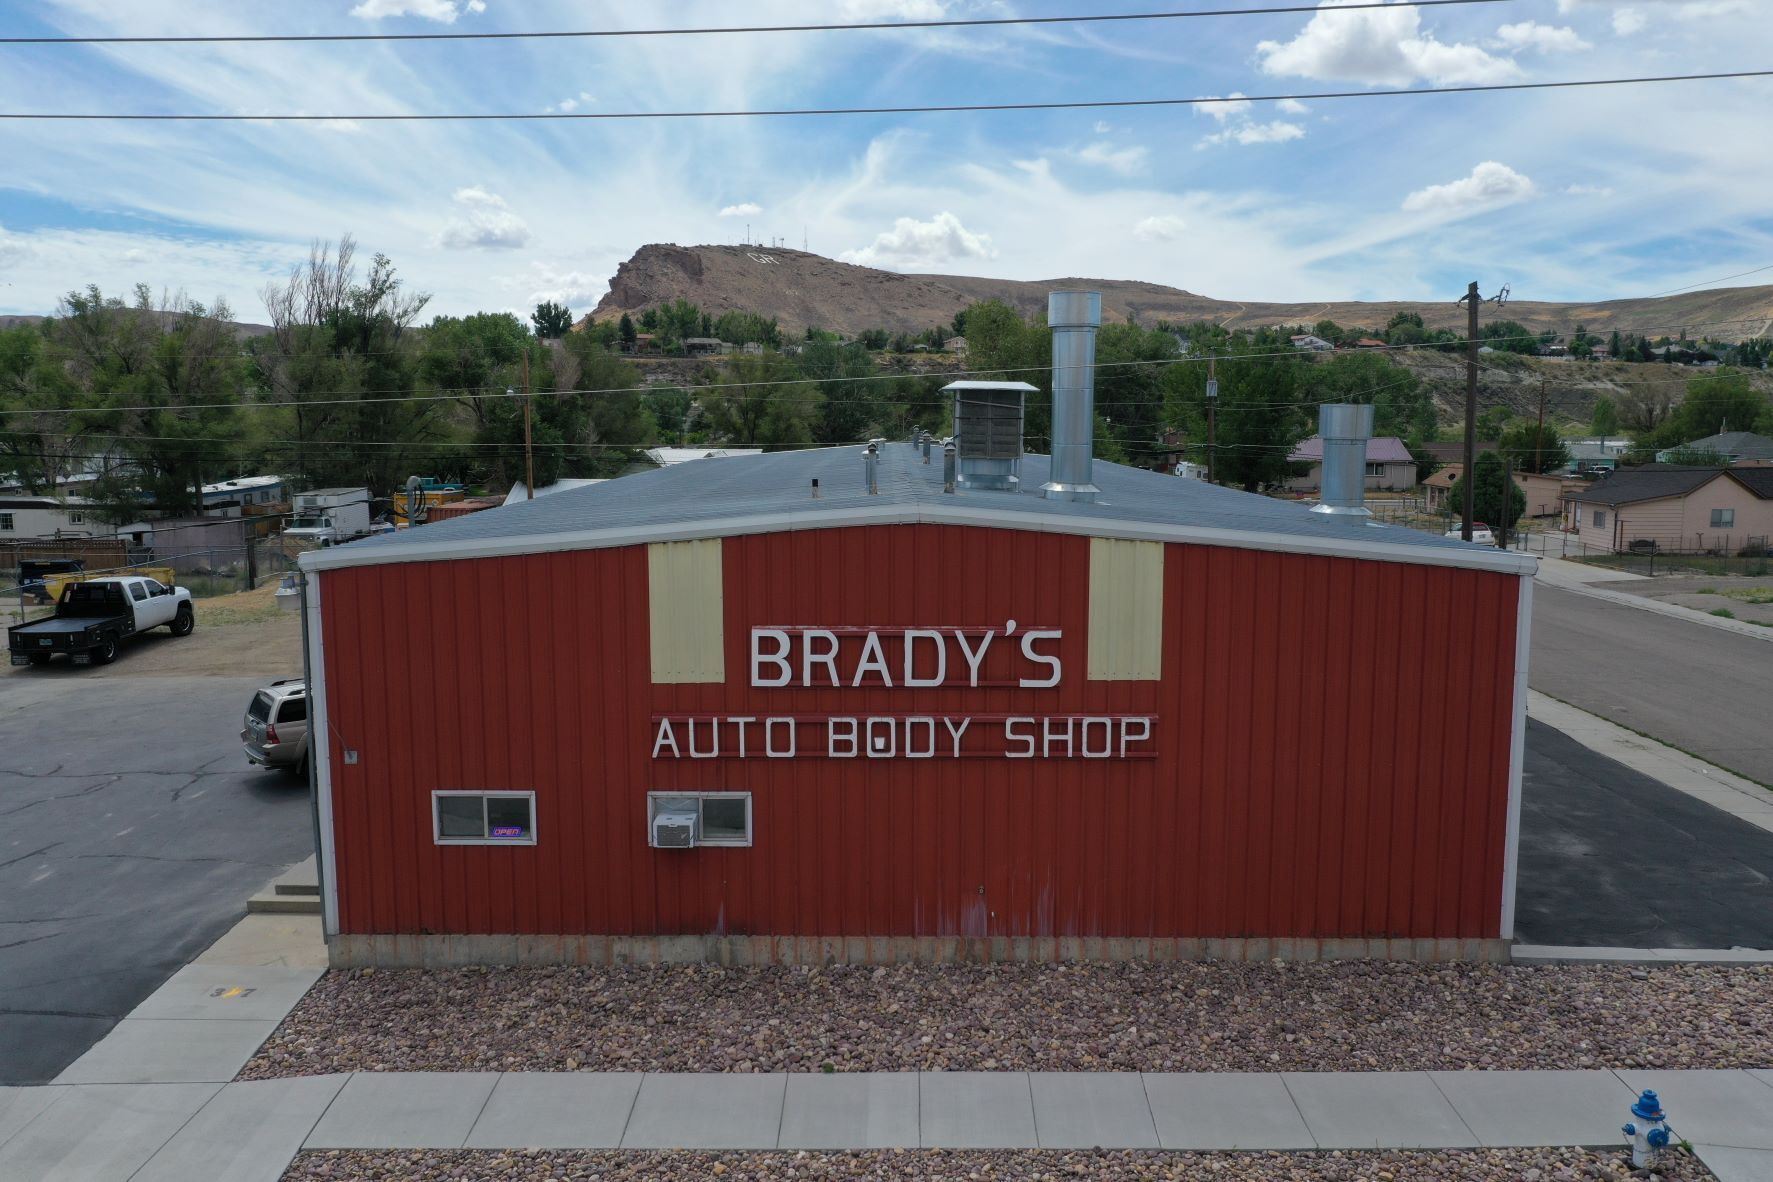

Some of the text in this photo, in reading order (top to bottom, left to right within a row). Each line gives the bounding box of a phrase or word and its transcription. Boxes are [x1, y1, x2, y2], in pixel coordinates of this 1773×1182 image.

[751, 619, 1062, 688] BRADY'S
[652, 716, 1150, 758] AUTO BODY SHOP
[494, 828, 520, 836] OPEN
